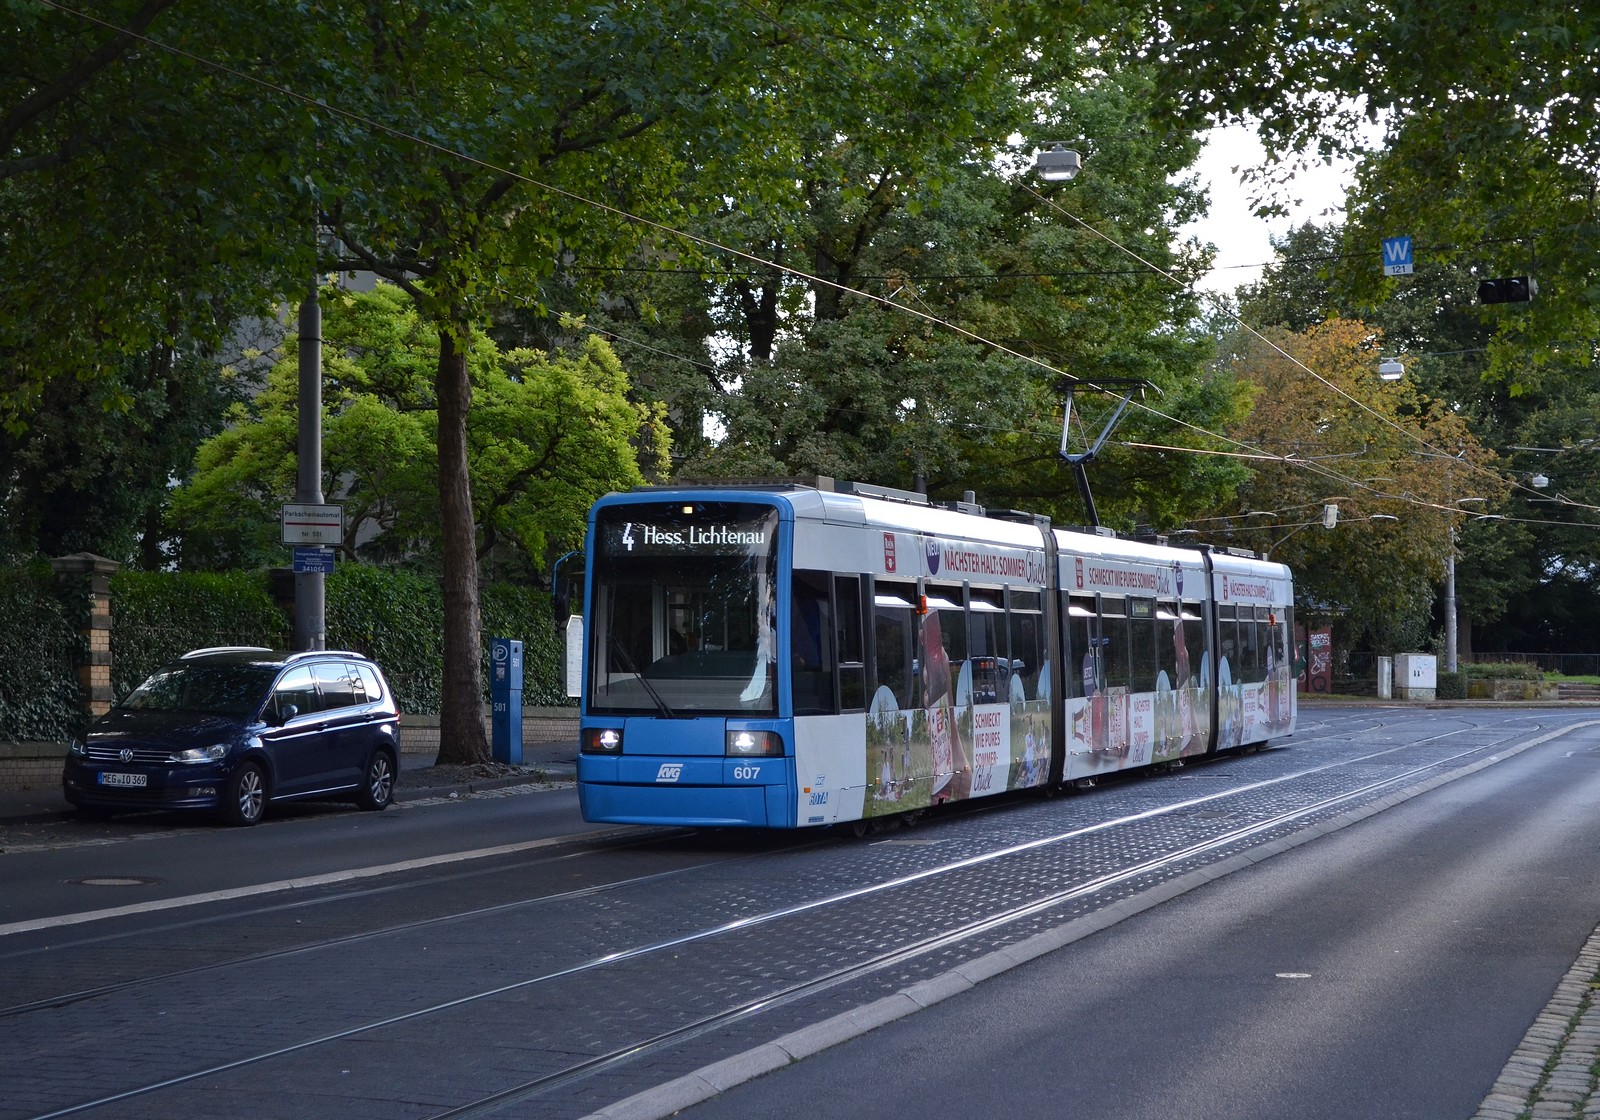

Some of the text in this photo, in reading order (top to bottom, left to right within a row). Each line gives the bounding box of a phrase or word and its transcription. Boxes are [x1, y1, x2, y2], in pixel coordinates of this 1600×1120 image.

[1385, 240, 1409, 262] W
[1391, 265, 1406, 274] 121
[284, 510, 340, 519] Parkscheinautomat
[622, 522, 765, 551] 4 Hess. Lichtenau
[944, 546, 981, 573] NÄCHSTER
[980, 554, 999, 575] HALT:
[494, 702, 506, 712] 501
[975, 712, 1001, 729] SCHMECKT
[975, 731, 1001, 748] WIE PURES
[103, 774, 116, 784] MEG
[132, 775, 146, 785] 369
[656, 765, 761, 781] KVG 607
[809, 791, 829, 806] 607A
